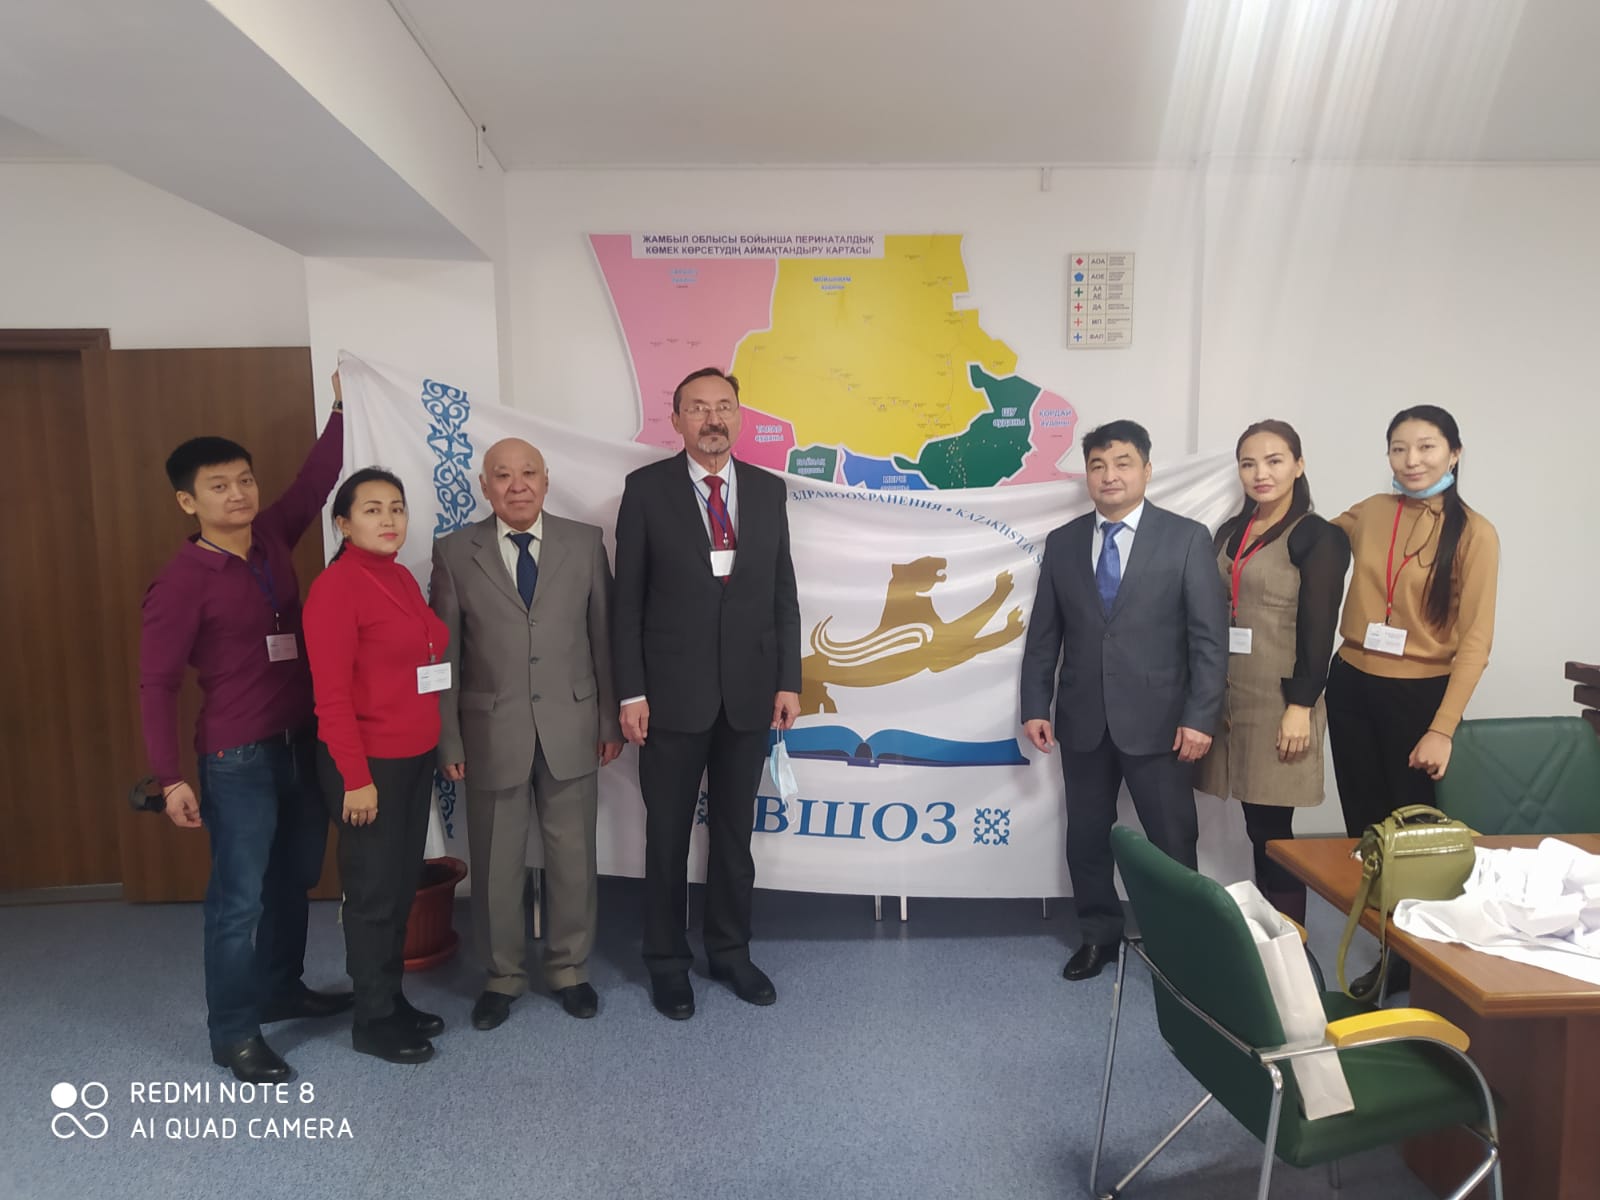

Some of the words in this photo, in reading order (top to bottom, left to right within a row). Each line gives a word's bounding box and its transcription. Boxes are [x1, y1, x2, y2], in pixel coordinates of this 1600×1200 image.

[643, 235, 689, 244] ЖАМБЫЛ
[691, 235, 738, 244] ОБЛЫСЫ
[740, 233, 793, 244] БОЙЫНША
[795, 235, 874, 245] ПЕРИНАТАЛДЫҚ
[645, 246, 680, 255] КӨМЕК
[743, 244, 823, 256] АЙМАҚТАНДЫРУ
[825, 246, 872, 255] КАРТАСЫ
[790, 489, 942, 512] ЗДРАВООХРАНЕНИЯ
[752, 795, 958, 845] ВШОЗ
